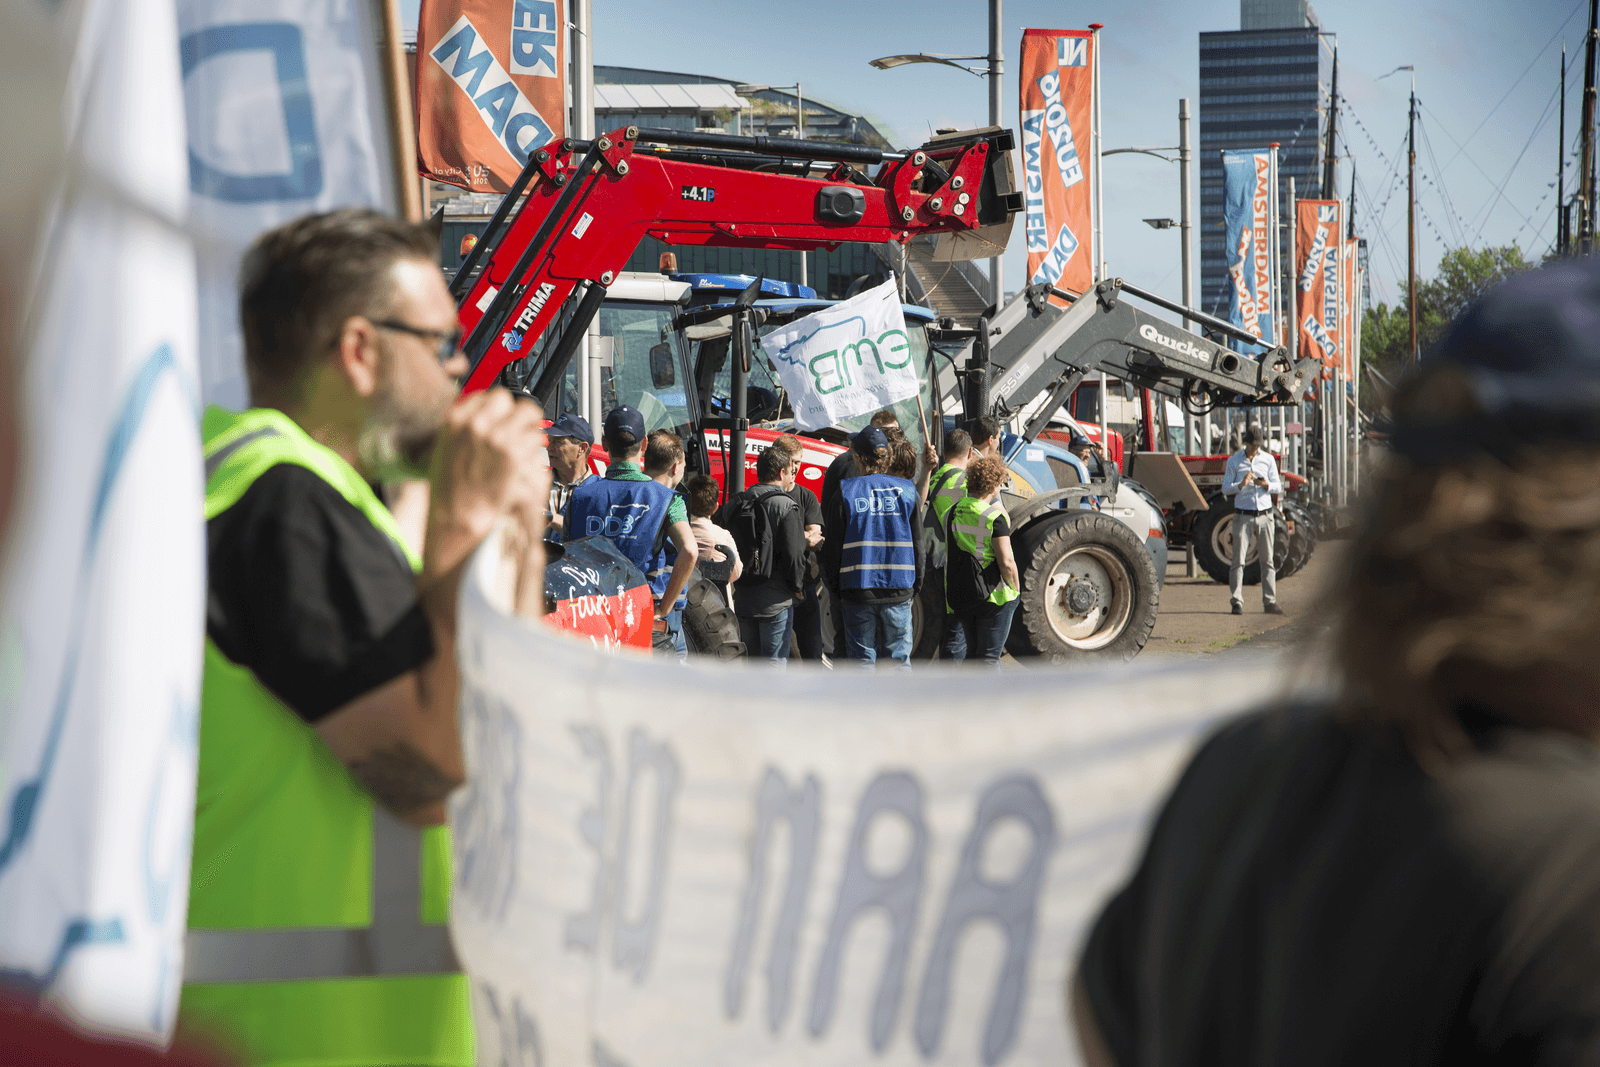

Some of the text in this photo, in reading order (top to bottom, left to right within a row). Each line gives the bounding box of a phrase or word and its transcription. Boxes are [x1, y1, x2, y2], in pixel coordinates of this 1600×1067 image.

[1253, 155, 1269, 312] AMSTERDAM
[513, 282, 557, 331] TRIMA
[854, 496, 895, 513] DDB
